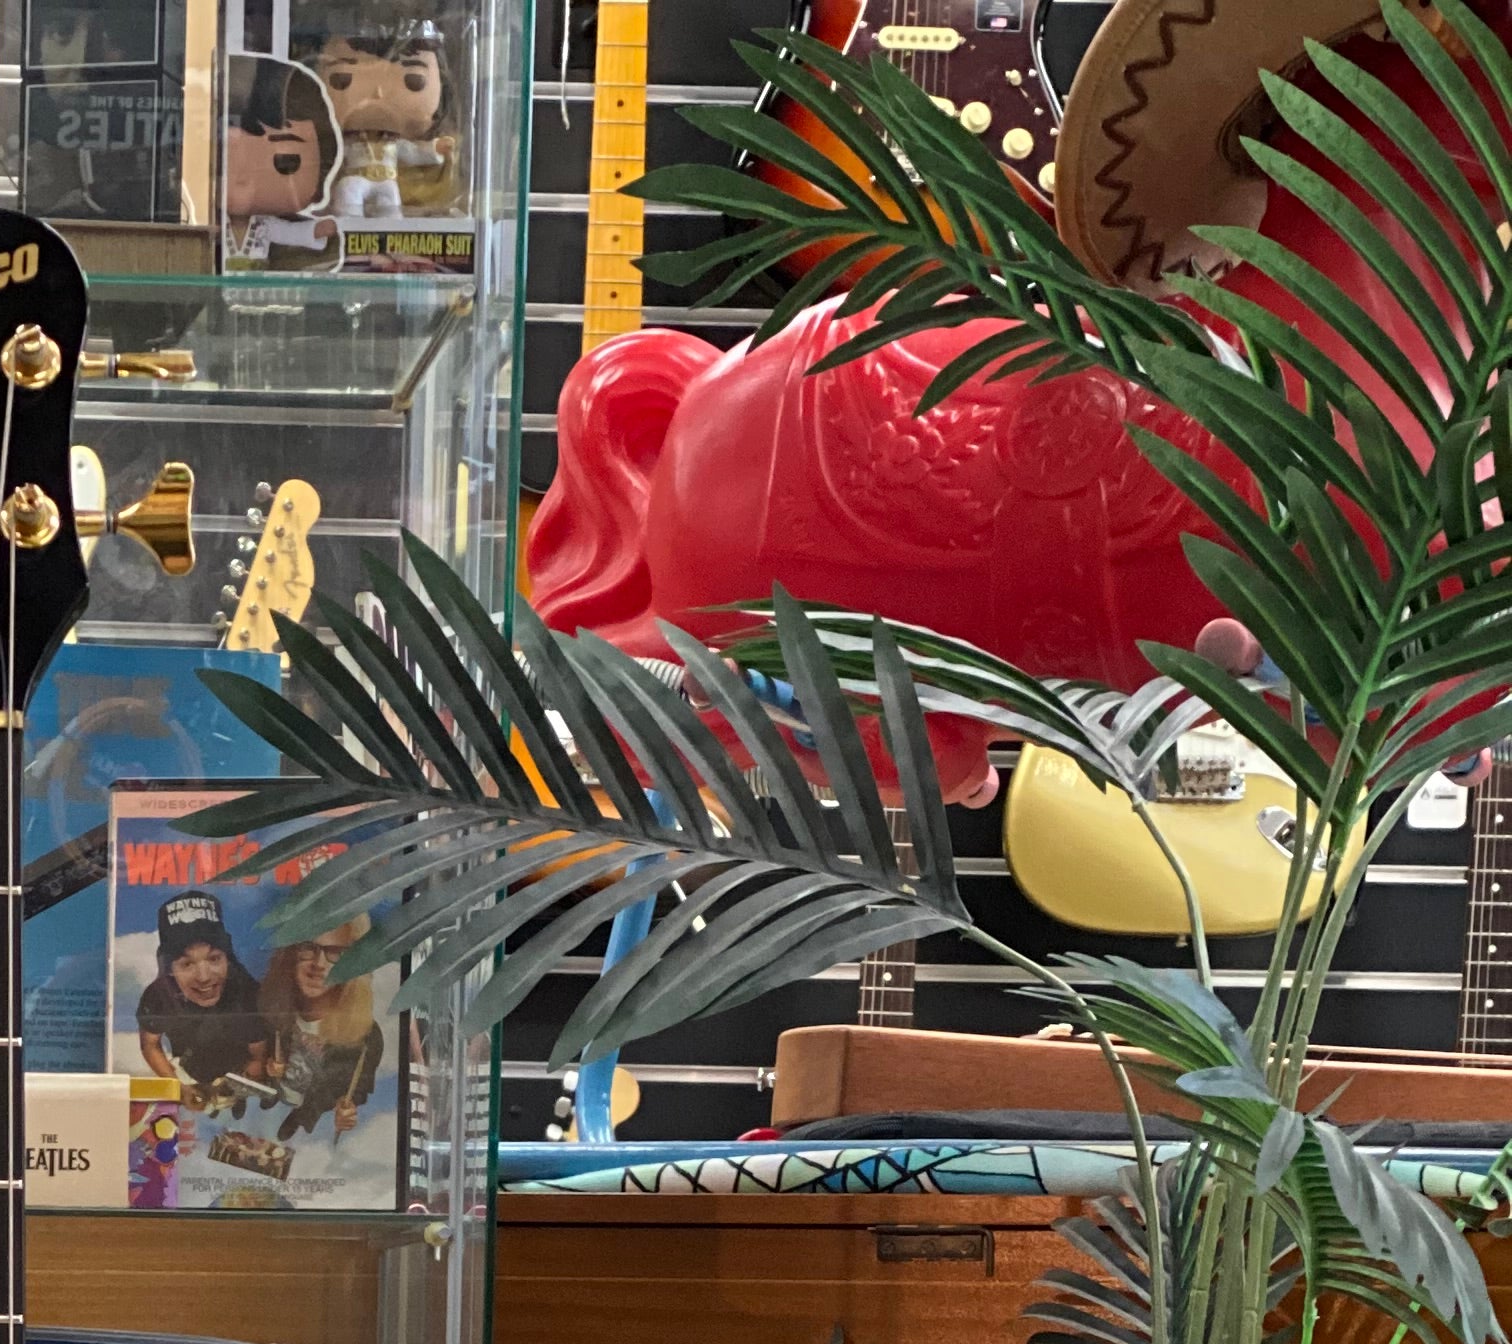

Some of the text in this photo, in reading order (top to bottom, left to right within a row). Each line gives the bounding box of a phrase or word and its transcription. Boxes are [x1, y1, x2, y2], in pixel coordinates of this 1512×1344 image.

[348, 233, 473, 255] ELVIS PHARAOH SUIT
[41, 1134, 58, 1143] THE
[26, 1148, 90, 1177] EATLES
